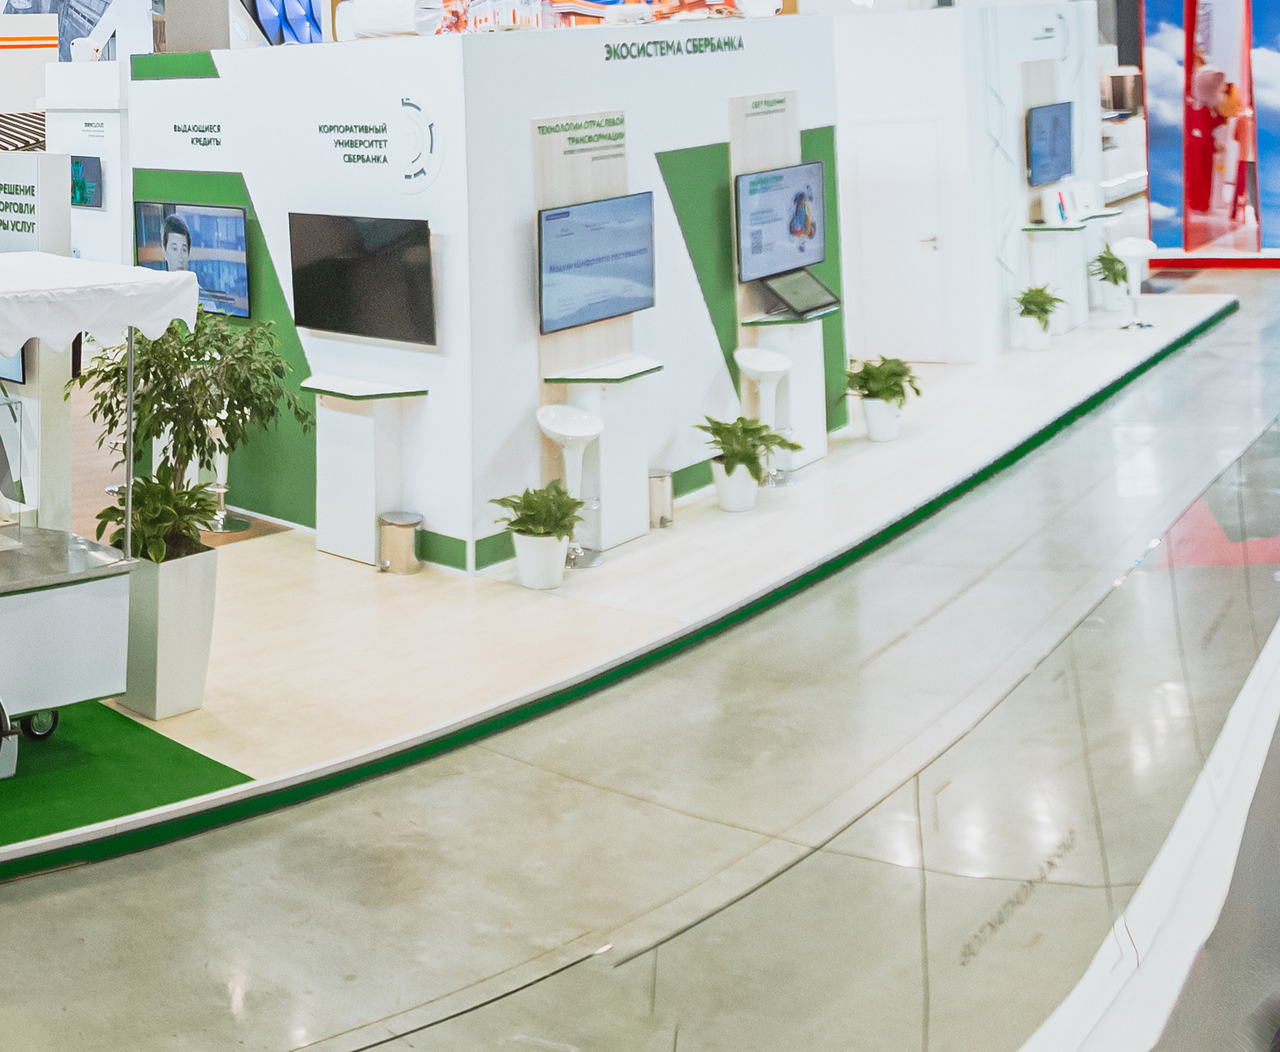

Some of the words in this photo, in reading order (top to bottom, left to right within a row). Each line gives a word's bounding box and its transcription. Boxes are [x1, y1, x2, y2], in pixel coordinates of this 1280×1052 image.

[604, 40, 683, 61] ЭКОСИСТЕМА
[685, 35, 745, 55] СБЕРБАНКА
[173, 124, 221, 133] ВЫДАЮЩИЕСЯ
[318, 122, 388, 134] КОРПОРАТИВНЫЙ
[190, 137, 221, 147] КРЕДИТЫ
[333, 139, 388, 149] УНИВЕРСИТЕТ
[343, 153, 388, 164] СБЕРБАНКА
[10, 220, 36, 233] УСЛУГ
